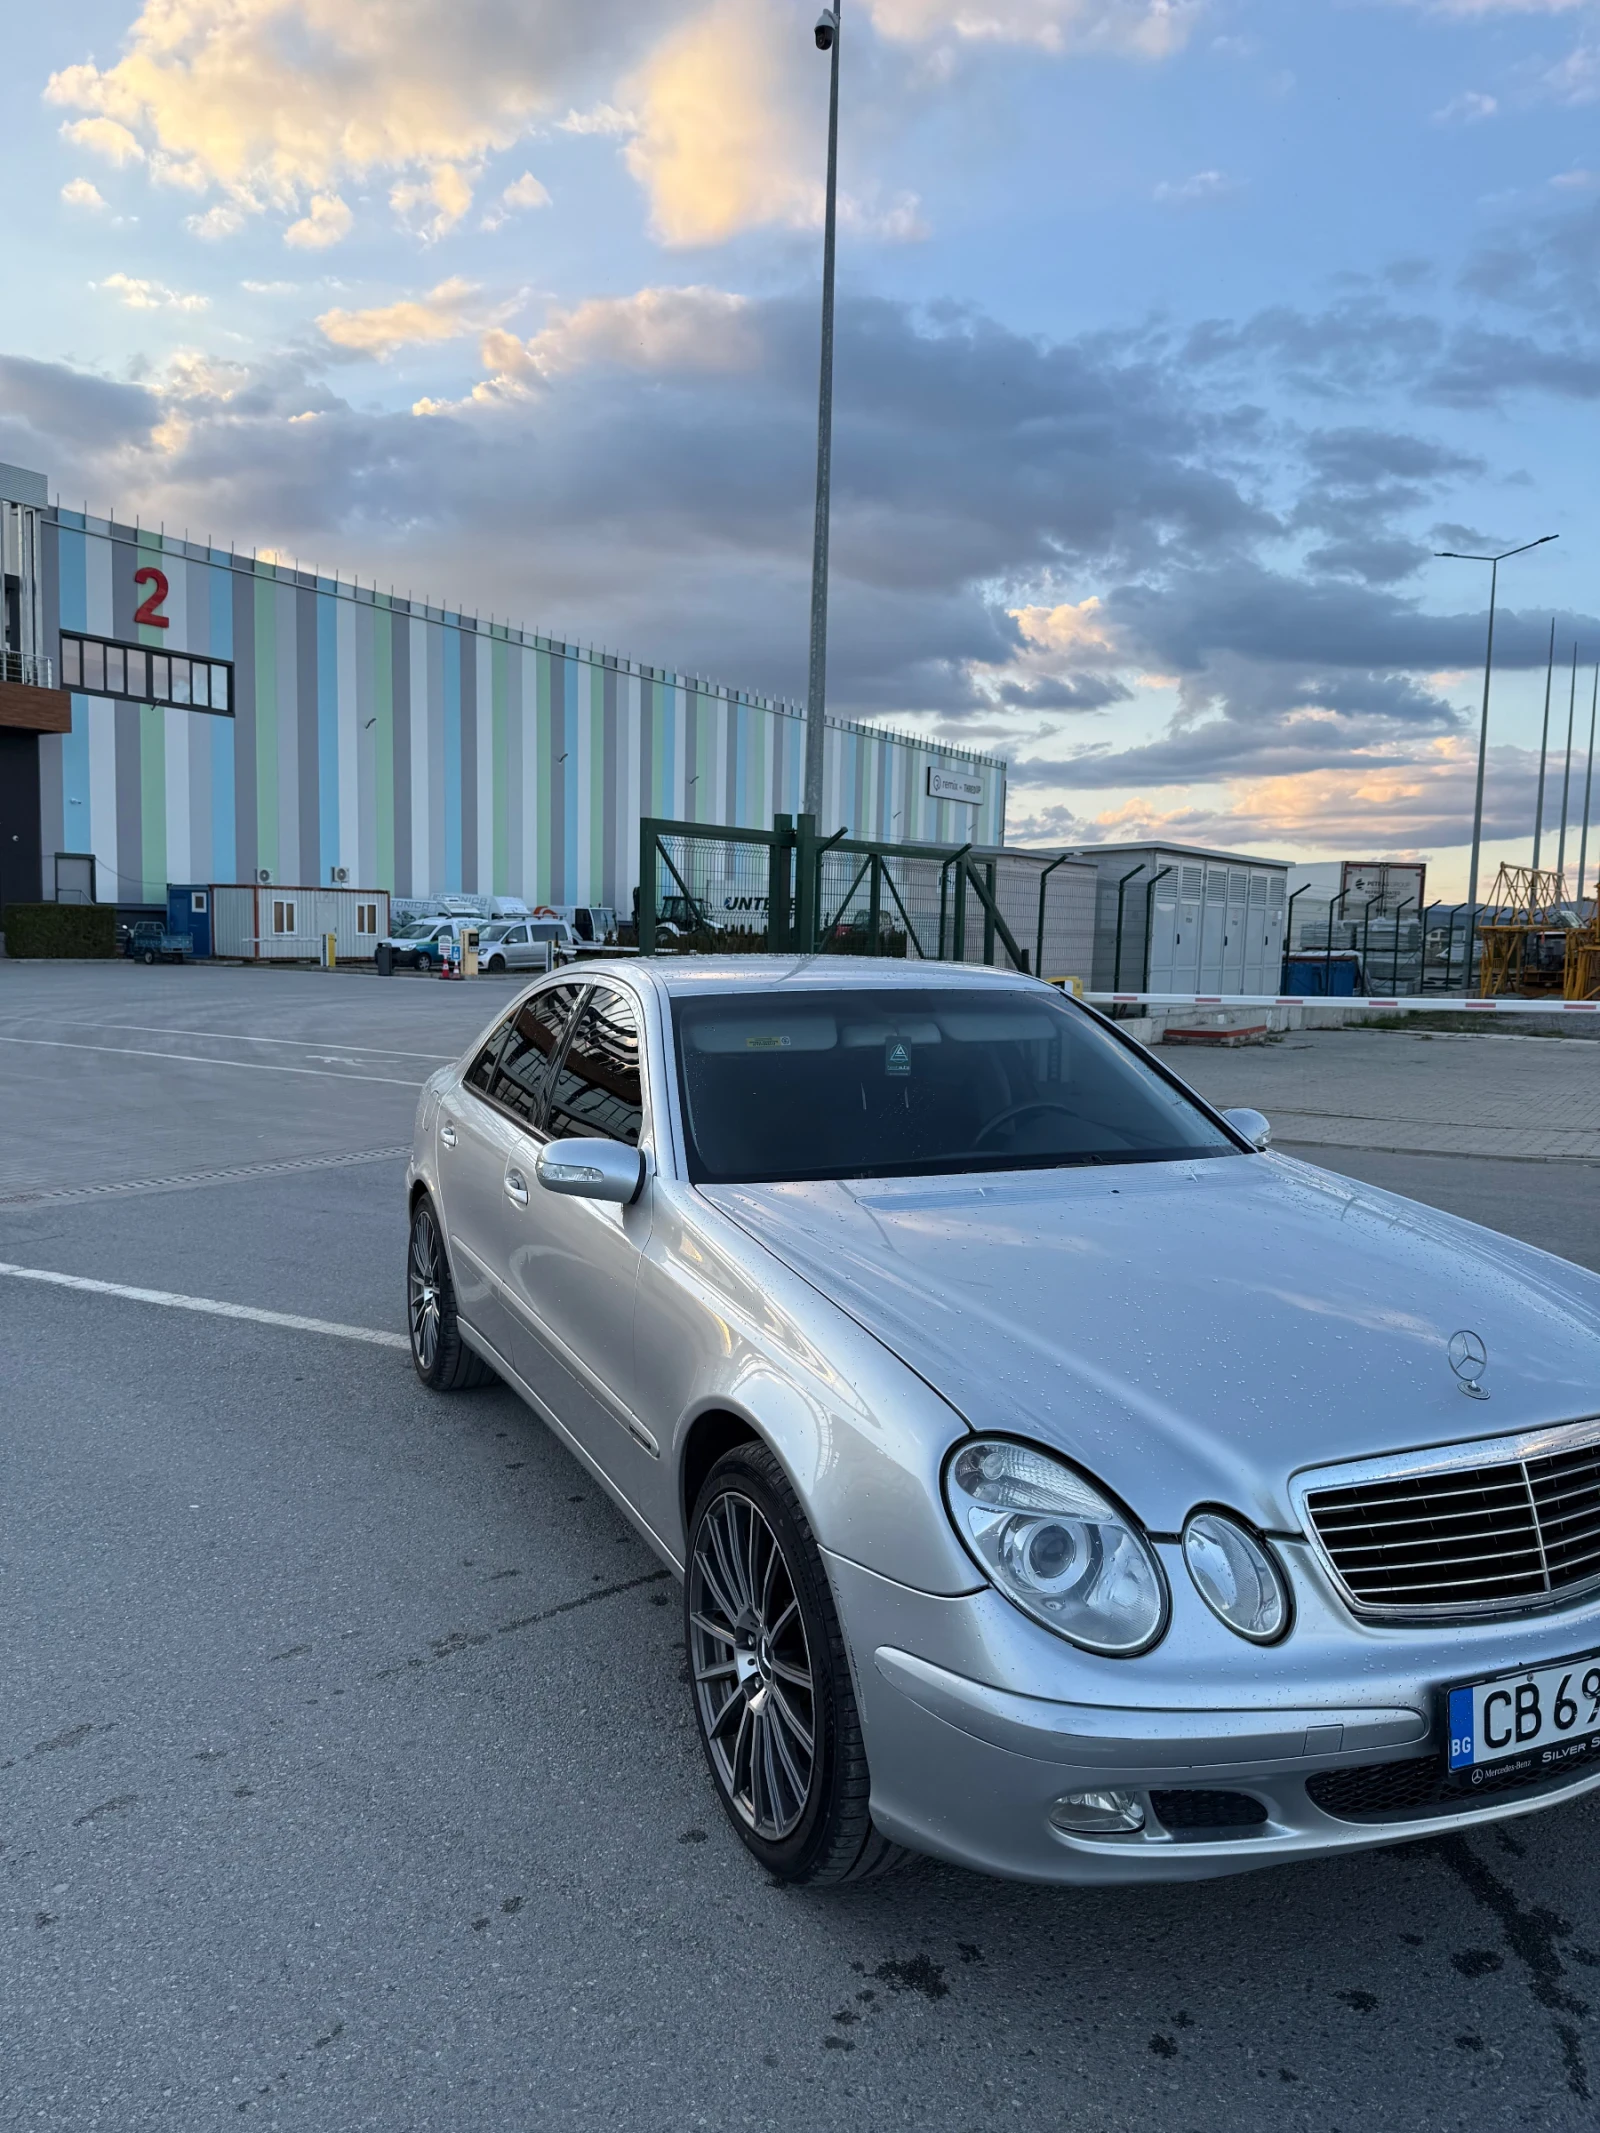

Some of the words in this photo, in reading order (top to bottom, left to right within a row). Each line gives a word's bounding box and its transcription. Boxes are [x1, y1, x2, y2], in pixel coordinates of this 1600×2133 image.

[134, 567, 170, 629] 2
[1484, 1682, 1542, 1749] CB
[1451, 1736, 1471, 1757] BG
[1484, 1760, 1532, 1779] Mercedes-Benz
